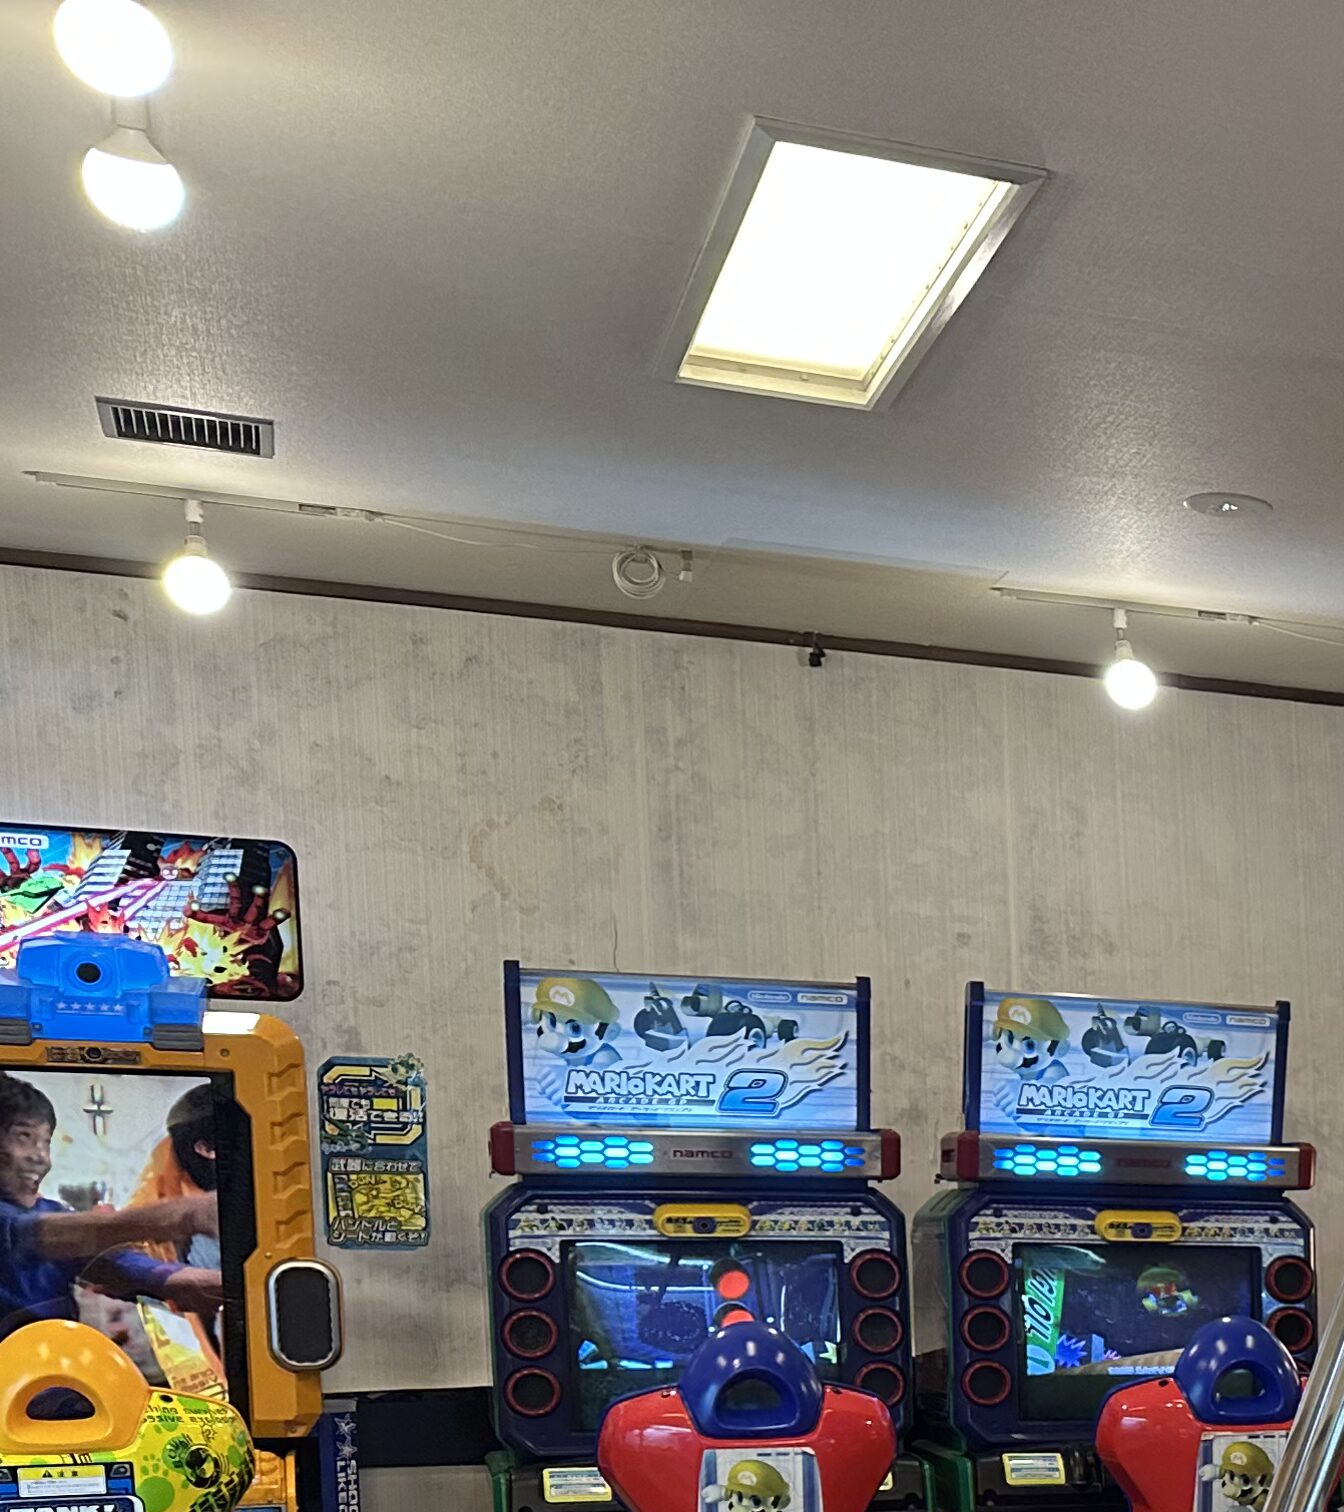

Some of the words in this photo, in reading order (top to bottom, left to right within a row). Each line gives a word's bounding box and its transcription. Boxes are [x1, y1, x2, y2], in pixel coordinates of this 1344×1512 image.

[719, 1069, 789, 1113] 2
[1151, 1085, 1213, 1127] 2
[673, 1149, 734, 1159] namco
[336, 1460, 347, 1504] LIKE
